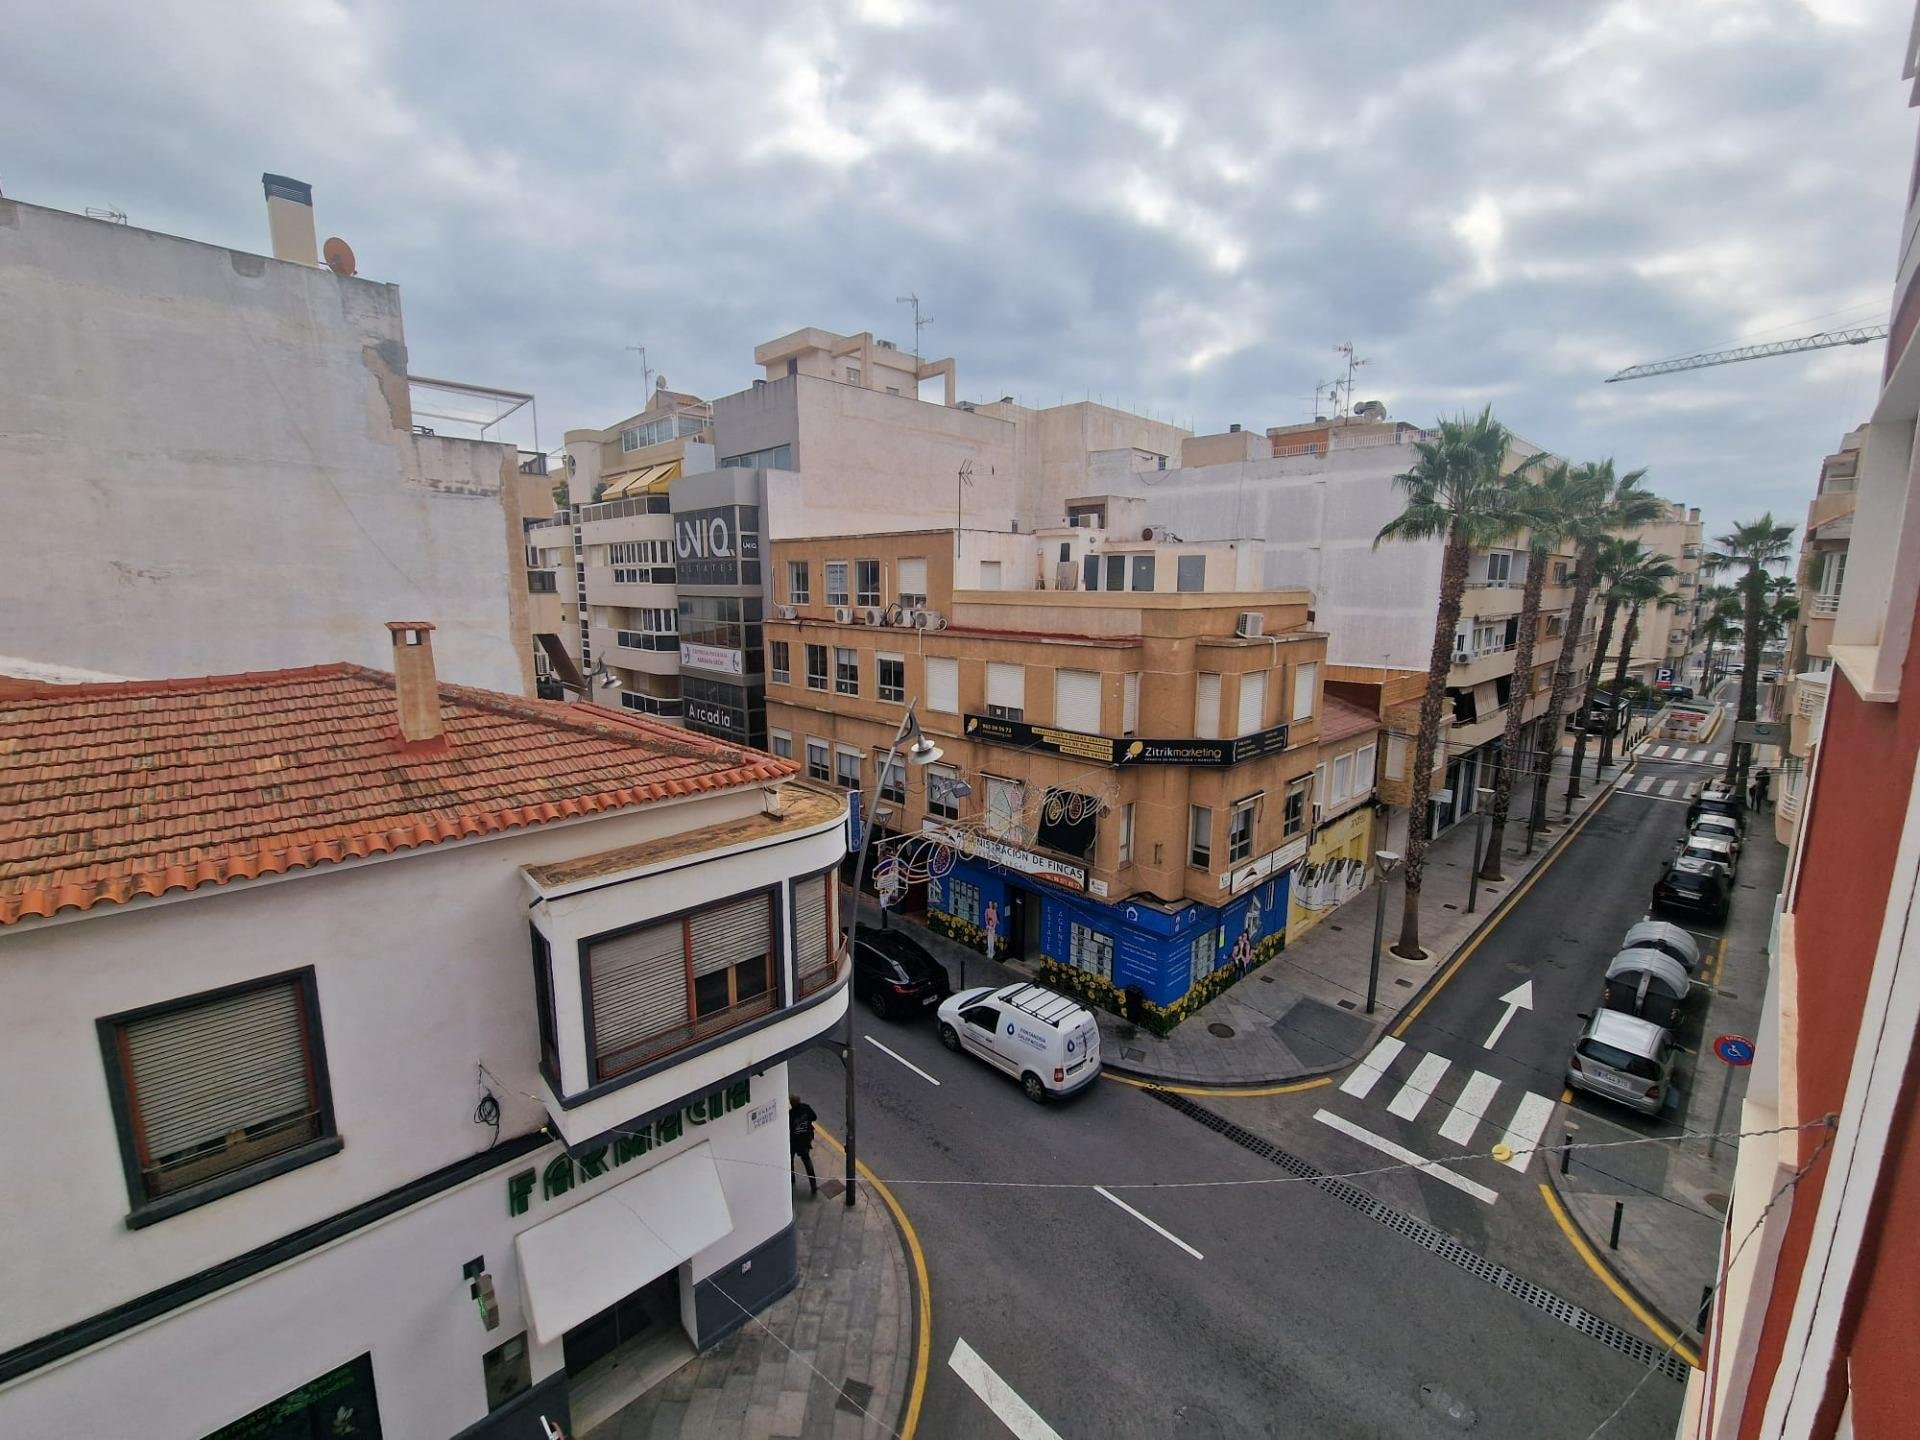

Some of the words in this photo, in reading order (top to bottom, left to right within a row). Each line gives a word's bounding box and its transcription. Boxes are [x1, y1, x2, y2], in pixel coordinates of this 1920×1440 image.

[688, 702, 731, 727] Arcadia
[1033, 855, 1047, 867] DE
[1049, 860, 1084, 880] FINCAS
[508, 1078, 752, 1217] FARMACIA
